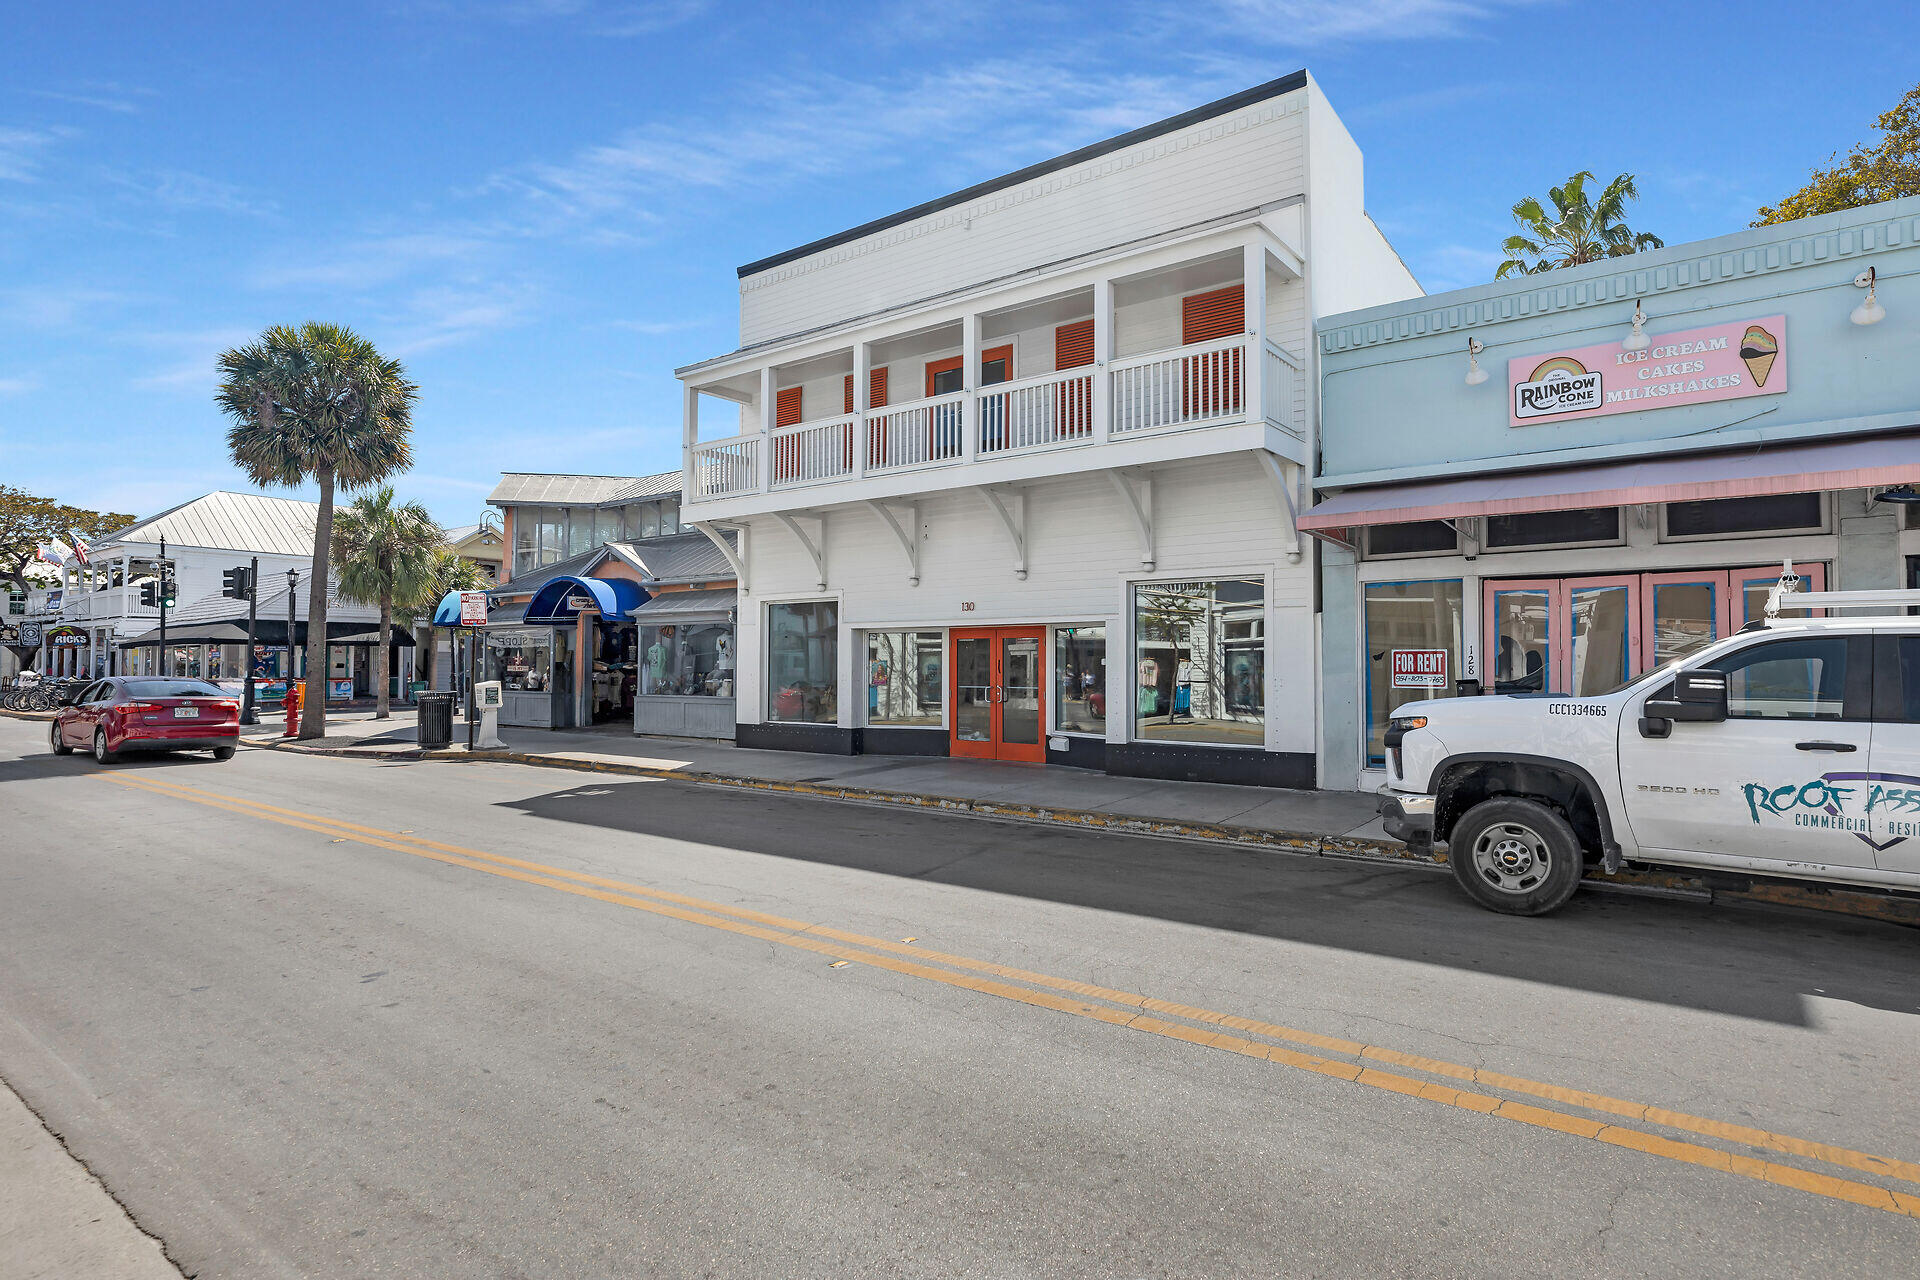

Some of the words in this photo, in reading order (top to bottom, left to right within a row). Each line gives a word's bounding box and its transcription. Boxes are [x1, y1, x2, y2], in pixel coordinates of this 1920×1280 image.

[1615, 350, 1649, 365] ICE
[1651, 337, 1728, 359] CREAM
[1638, 360, 1704, 380] CAKES
[1521, 377, 1596, 410] RAINBOW
[1558, 390, 1594, 403] CONE
[1606, 374, 1741, 403] MILKSHAKES
[961, 601, 975, 611] 130
[1395, 653, 1414, 672] FOR
[1417, 653, 1443, 672] RENT
[1467, 645, 1475, 675] 128
[1549, 703, 1607, 716] CCC1334665
[1739, 779, 1857, 825] ROOF
[1795, 813, 1873, 832] COMMERCIAL
[1888, 821, 1920, 836] RESI
